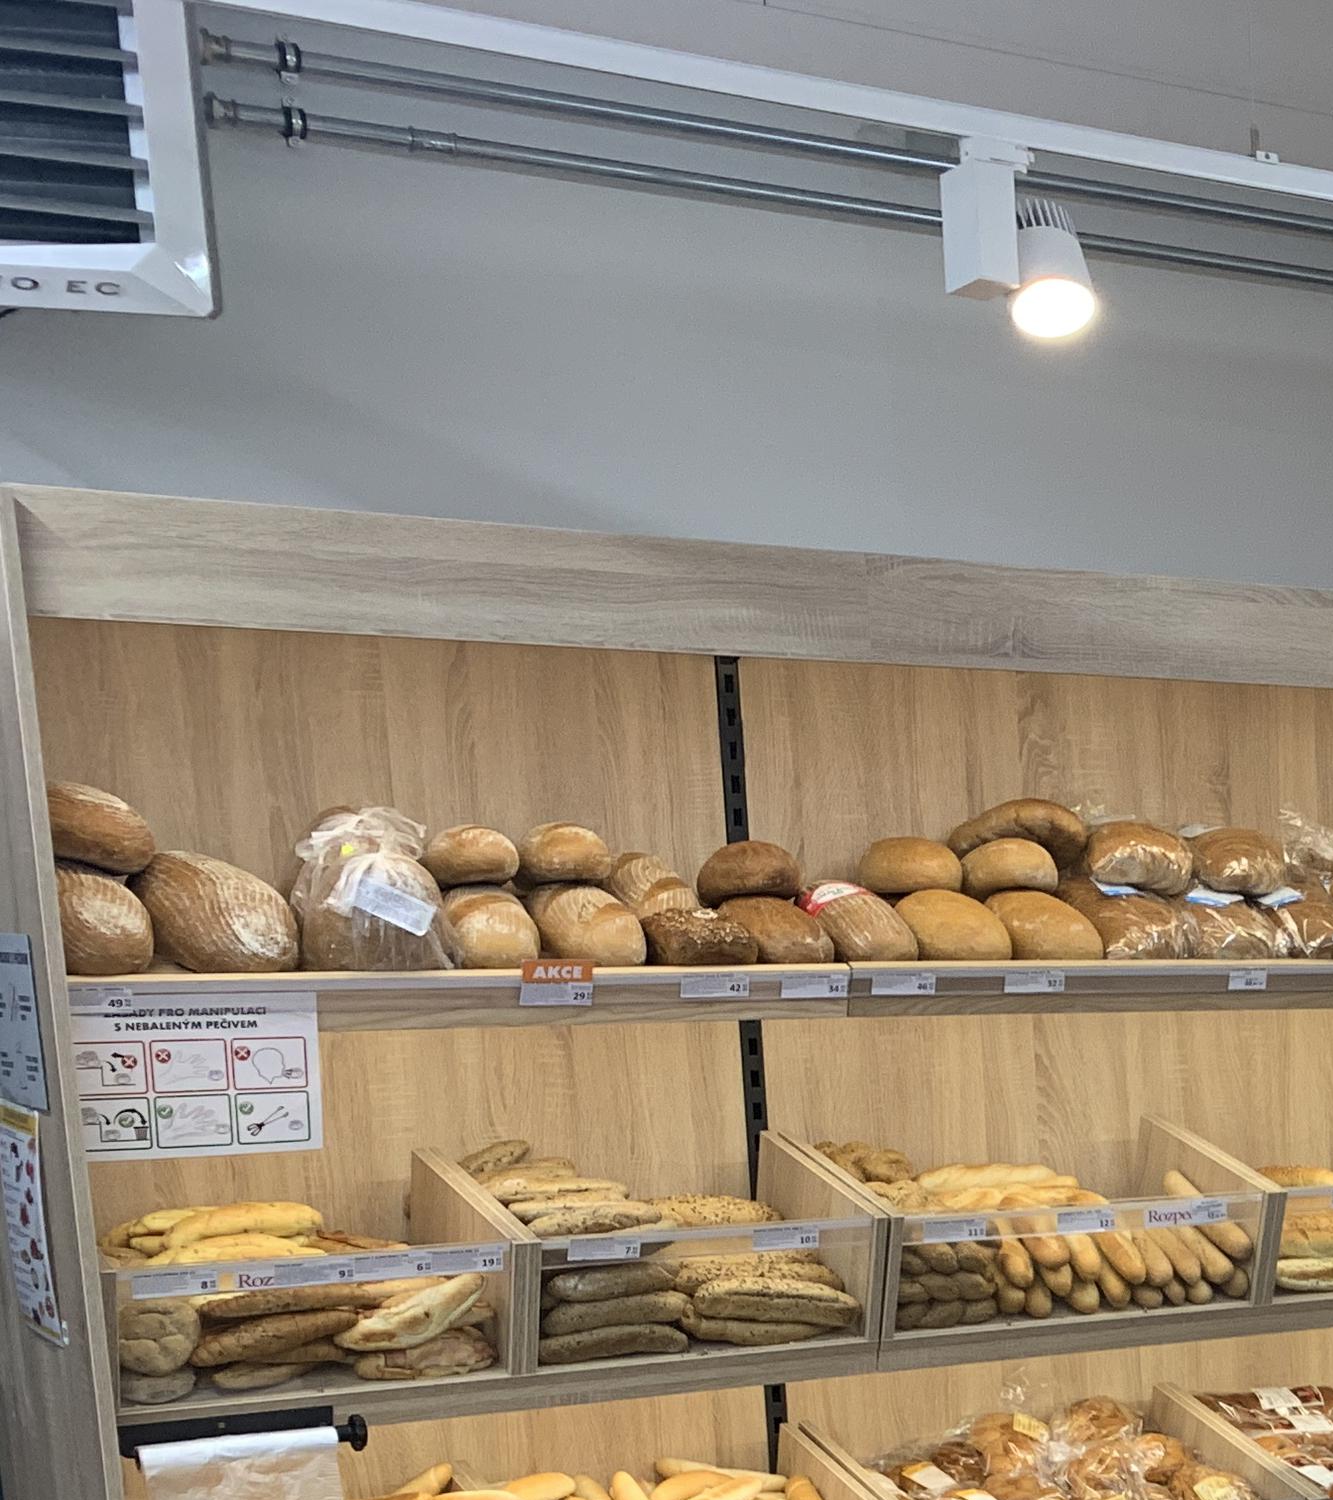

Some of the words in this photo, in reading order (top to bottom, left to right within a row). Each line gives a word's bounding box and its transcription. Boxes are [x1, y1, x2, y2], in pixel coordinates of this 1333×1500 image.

[66, 279, 121, 297] EC
[532, 965, 584, 981] AKCE
[106, 998, 124, 1009] 49
[157, 1006, 185, 1018] PRO
[124, 1018, 203, 1032] NEBALENÝM
[204, 1017, 259, 1030] PEČIVEM
